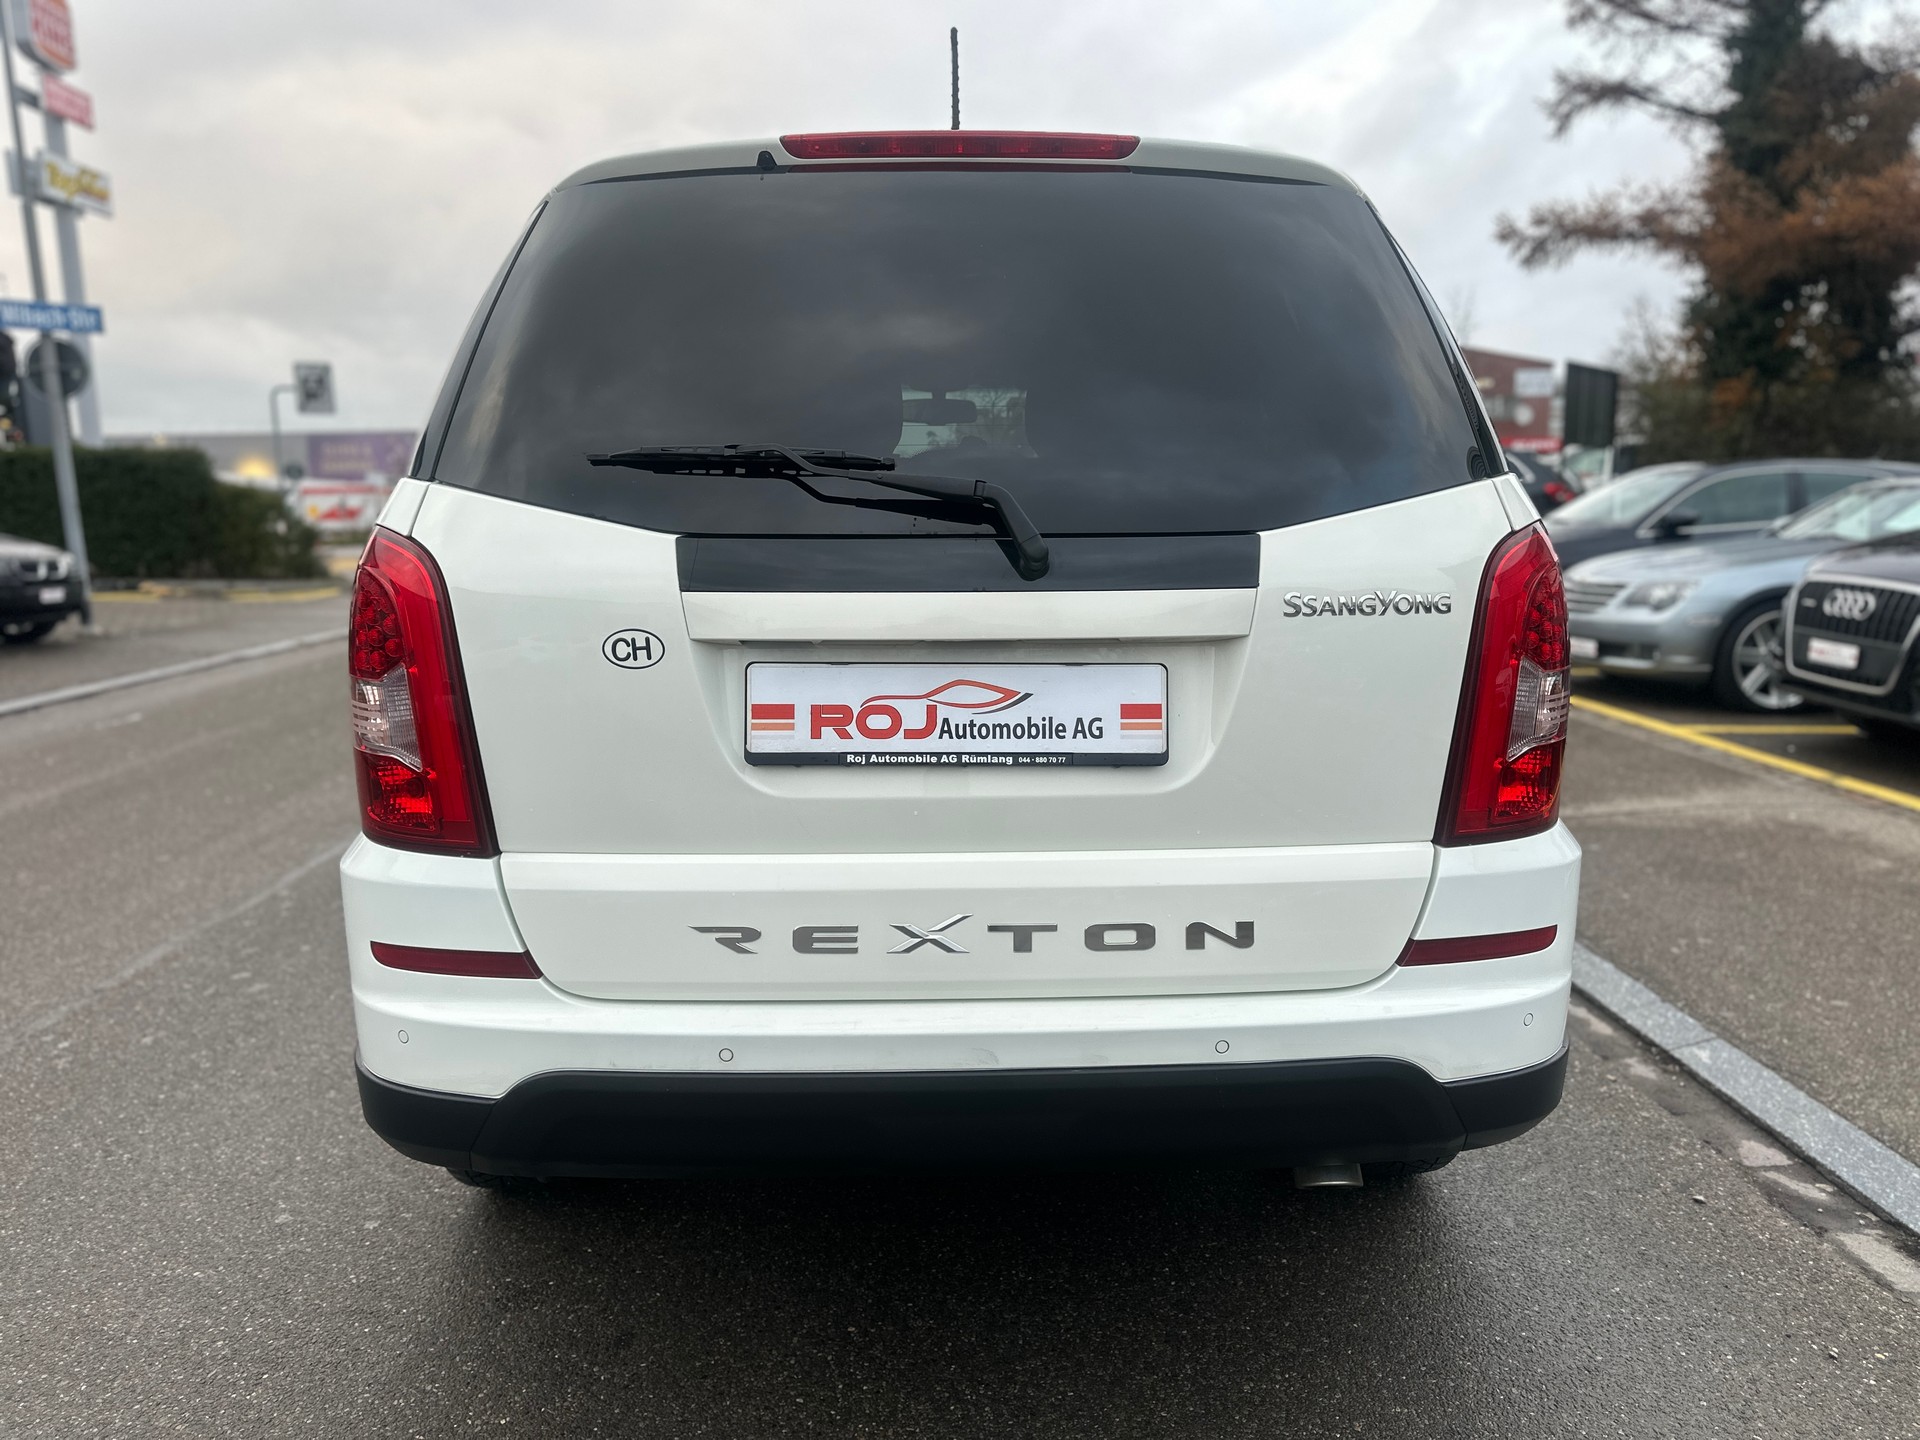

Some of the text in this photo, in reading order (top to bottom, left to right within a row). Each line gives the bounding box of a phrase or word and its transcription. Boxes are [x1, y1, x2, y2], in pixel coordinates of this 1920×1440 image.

[611, 636, 652, 662] CH
[810, 704, 1104, 740] ROJ Automobile AG
[846, 754, 866, 765] Roj
[869, 754, 938, 763] Automobile
[940, 754, 958, 763] AG
[961, 754, 1013, 765] Rümlang
[687, 913, 1255, 954] REXTON
